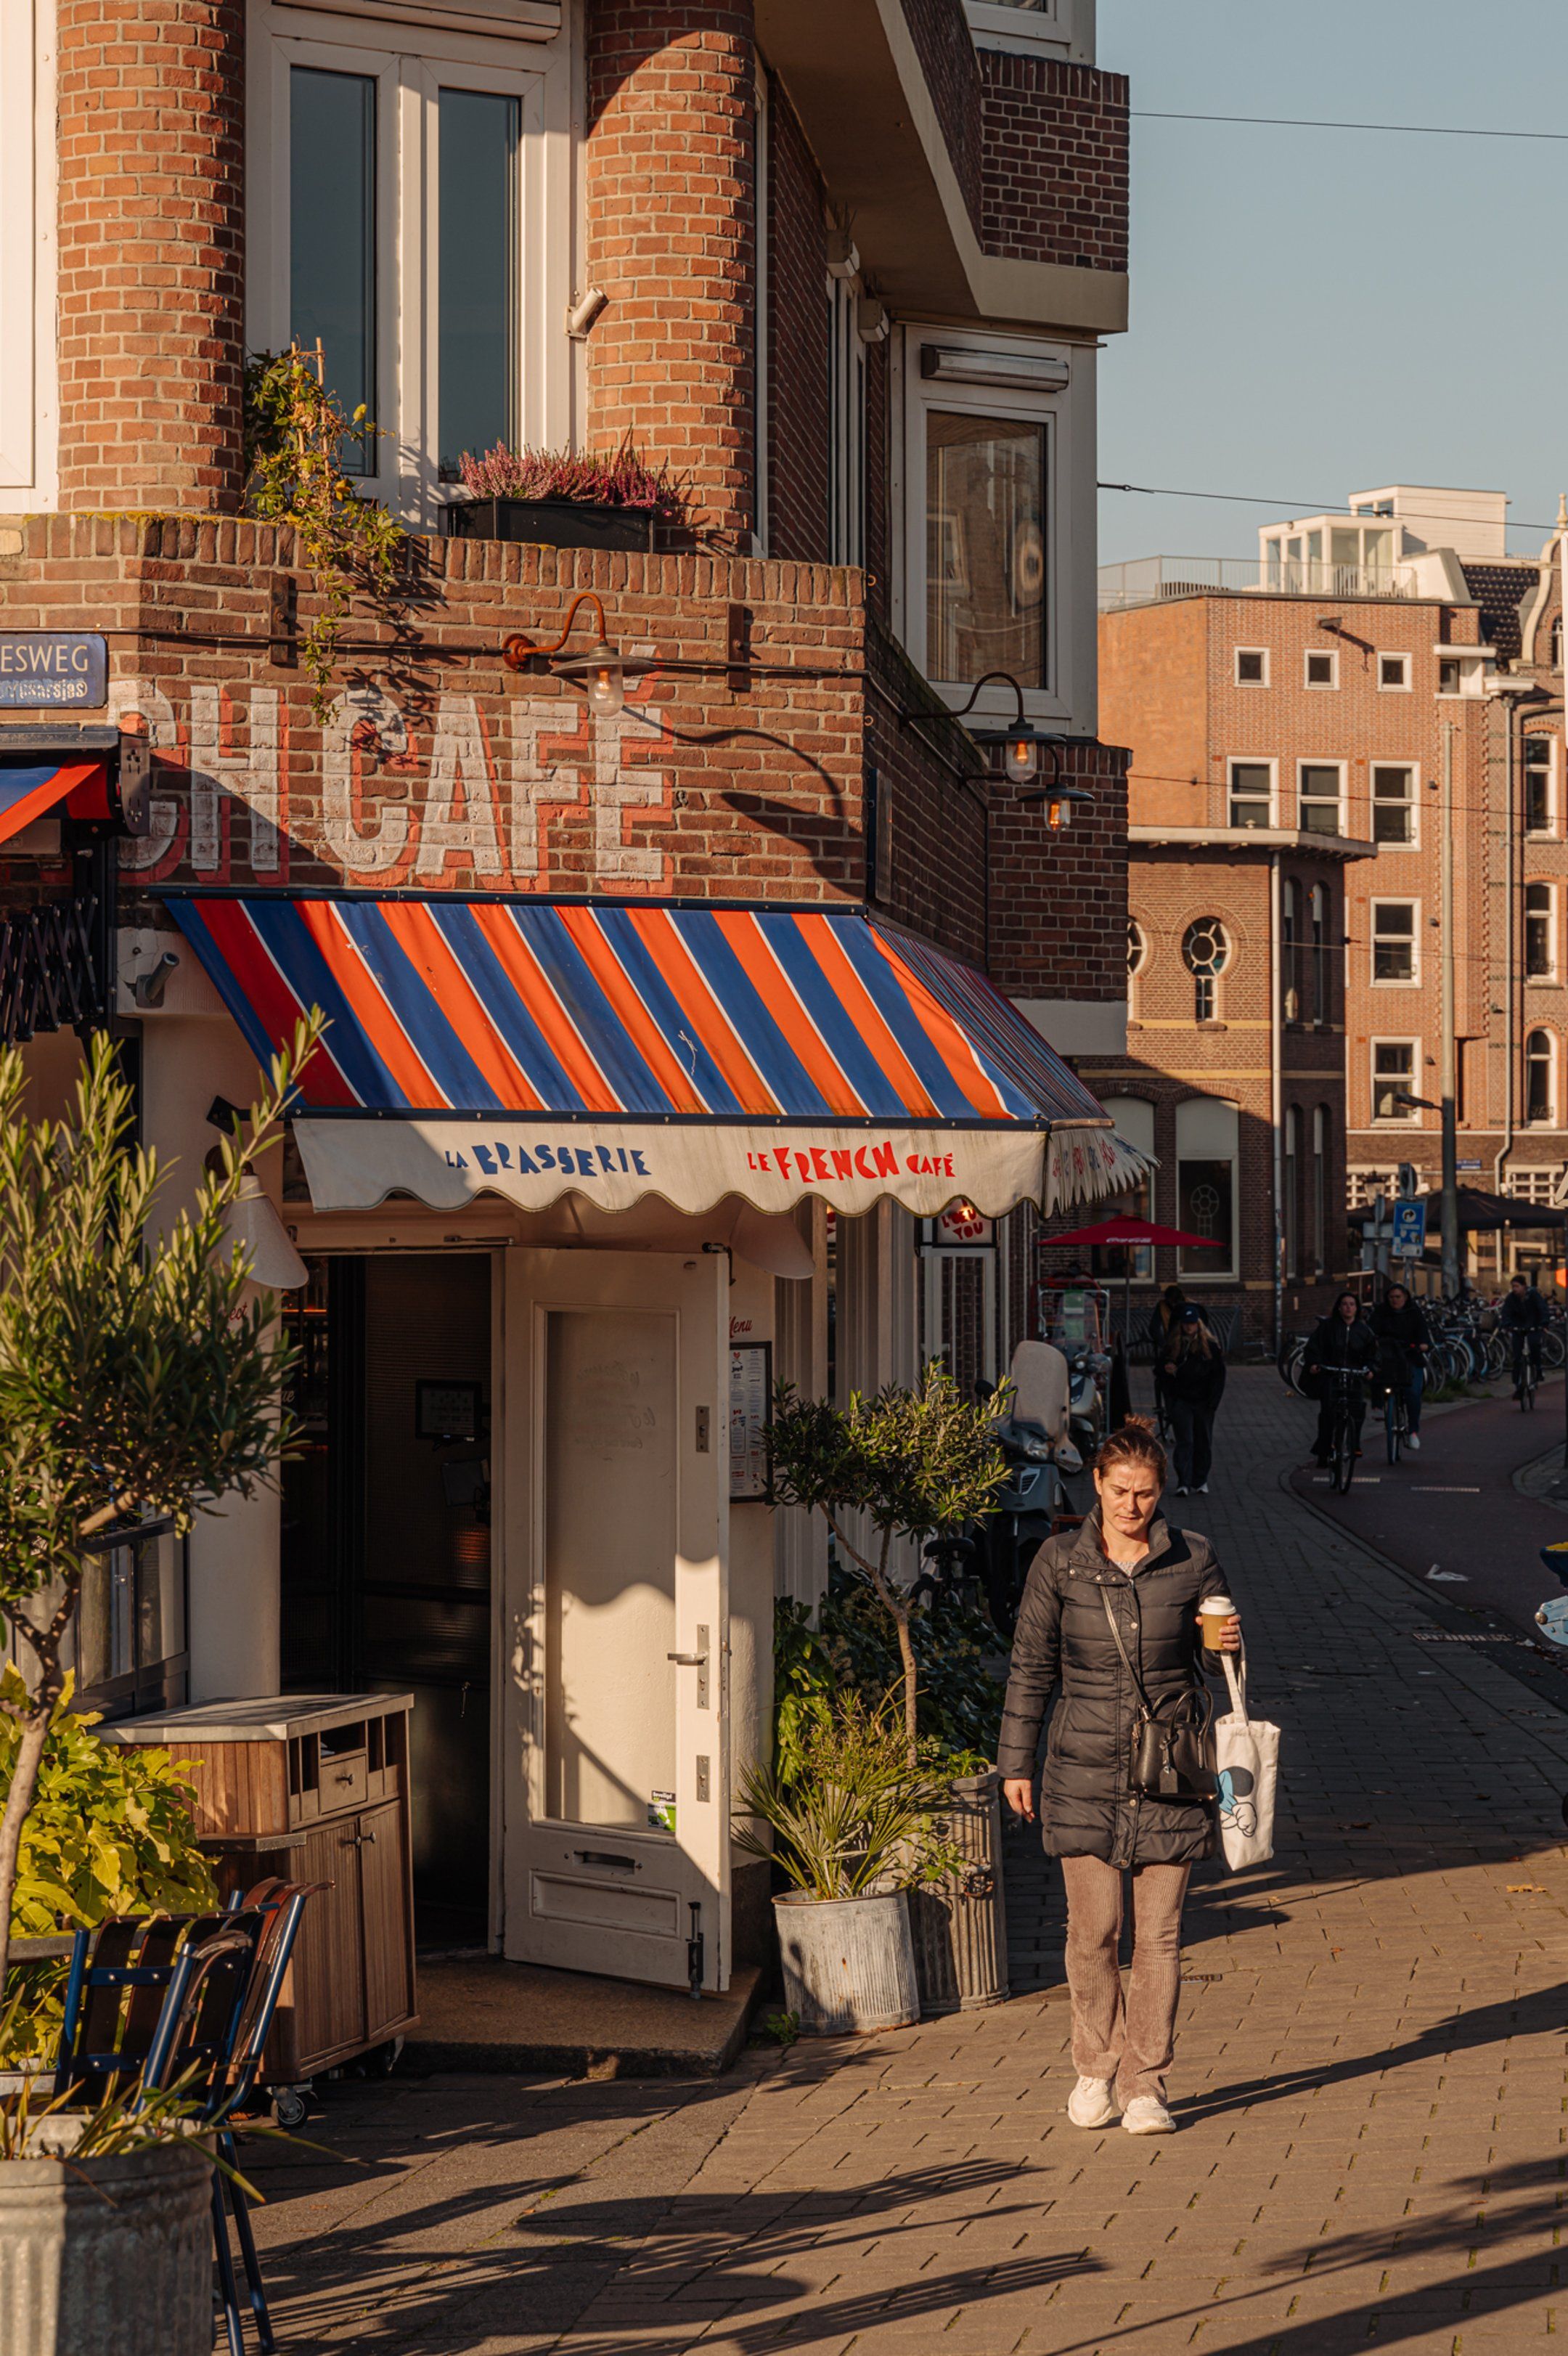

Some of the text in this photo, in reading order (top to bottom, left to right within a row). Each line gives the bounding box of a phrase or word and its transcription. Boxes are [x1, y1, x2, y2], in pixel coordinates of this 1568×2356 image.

[445, 1142, 652, 1176] LA BRASSERIE
[747, 1141, 956, 1183] LE FRENCH CAFÉ
